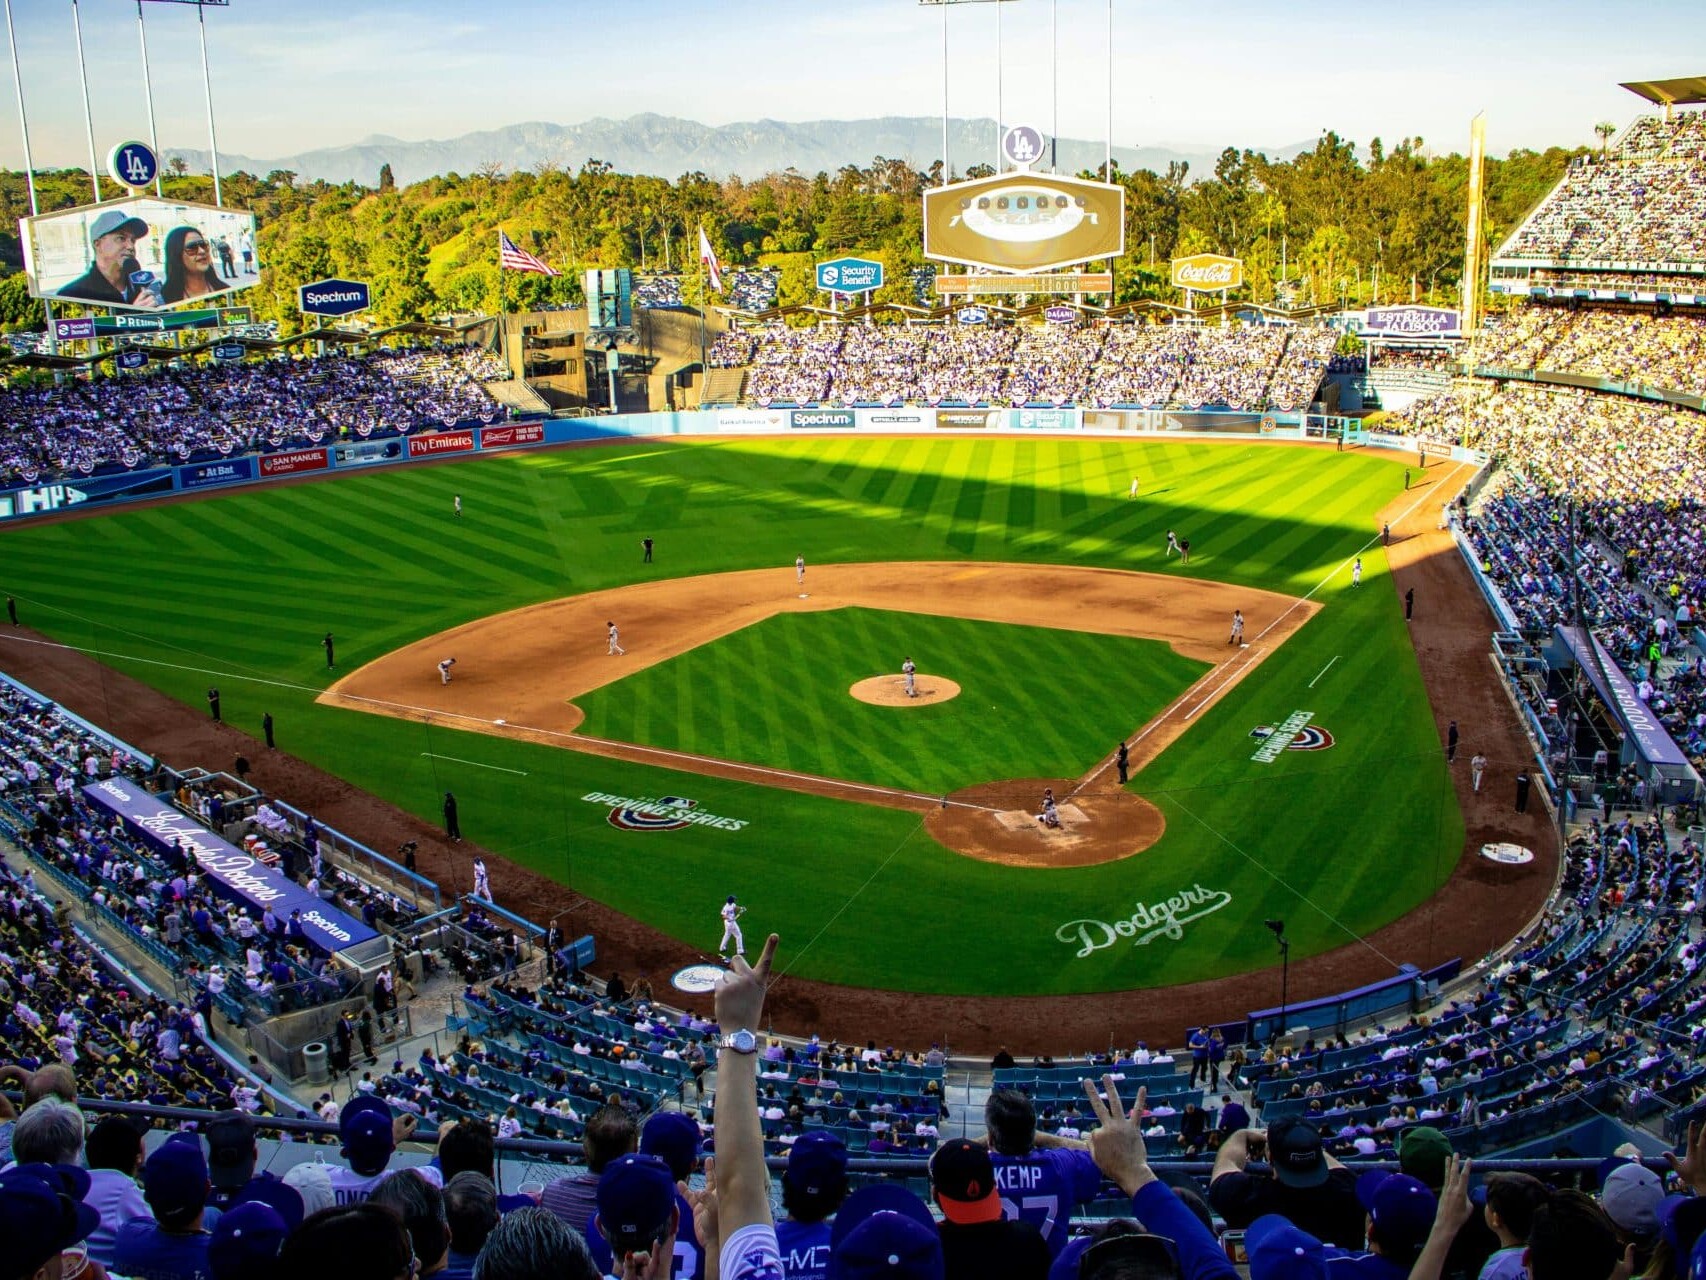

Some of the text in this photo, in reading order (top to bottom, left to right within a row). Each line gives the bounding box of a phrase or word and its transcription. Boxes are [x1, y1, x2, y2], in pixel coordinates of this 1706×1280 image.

[1013, 130, 1034, 160] LA
[124, 149, 148, 180] LA
[841, 265, 877, 277] Security
[842, 275, 872, 285] Benefit
[306, 290, 361, 306] Spectrum
[1047, 311, 1074, 319] DASANI
[1378, 312, 1448, 323] ESTRELLA
[1383, 321, 1441, 332] JALISCO
[794, 413, 848, 427] Spectrum
[1263, 421, 1273, 429] 76
[411, 435, 473, 452] Fly Emirates
[272, 452, 323, 467] SAN MANUEL
[273, 463, 294, 471] CASINO
[206, 465, 234, 477] At Bat
[1250, 710, 1315, 763] OPENING SERIES
[98, 781, 131, 801] Spectrum
[581, 791, 750, 831] OPENING SERIES
[133, 810, 183, 829] Los
[206, 856, 285, 901] Dodgers
[302, 909, 351, 942] Spectrum
[1055, 883, 1232, 958] Dodgers
[993, 1165, 1042, 1190] KEMP
